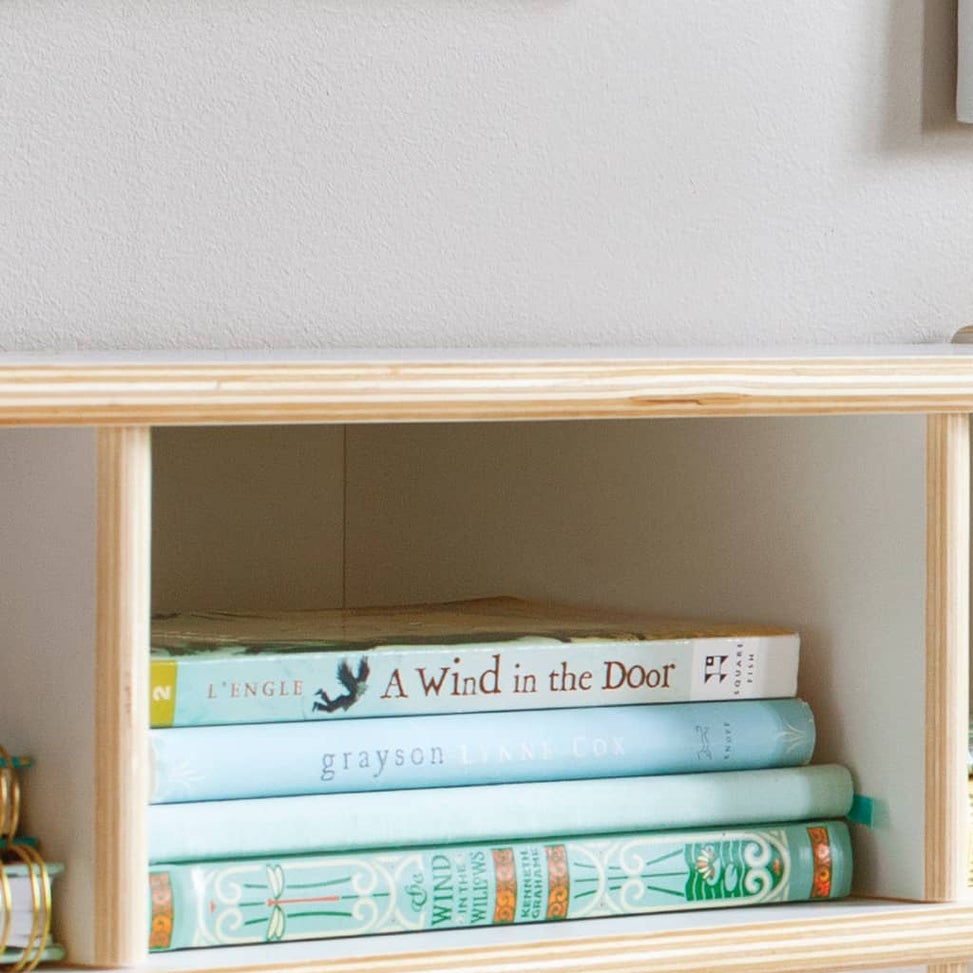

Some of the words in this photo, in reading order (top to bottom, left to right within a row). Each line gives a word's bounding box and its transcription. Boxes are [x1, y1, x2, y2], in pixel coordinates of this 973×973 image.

[380, 668, 408, 700] A
[414, 653, 502, 697] Wind
[512, 662, 537, 694] in
[549, 661, 593, 692] the
[746, 654, 754, 683] FISH
[207, 680, 304, 700] L'ENGLE
[319, 744, 445, 781] grayson
[572, 735, 626, 760] COX
[431, 854, 453, 926] WIND
[456, 863, 468, 893] THE
[470, 851, 489, 924] WILLOWS
[520, 849, 531, 918] KENNETH
[531, 847, 543, 919] GRAHAME
[457, 897, 468, 914] IN
